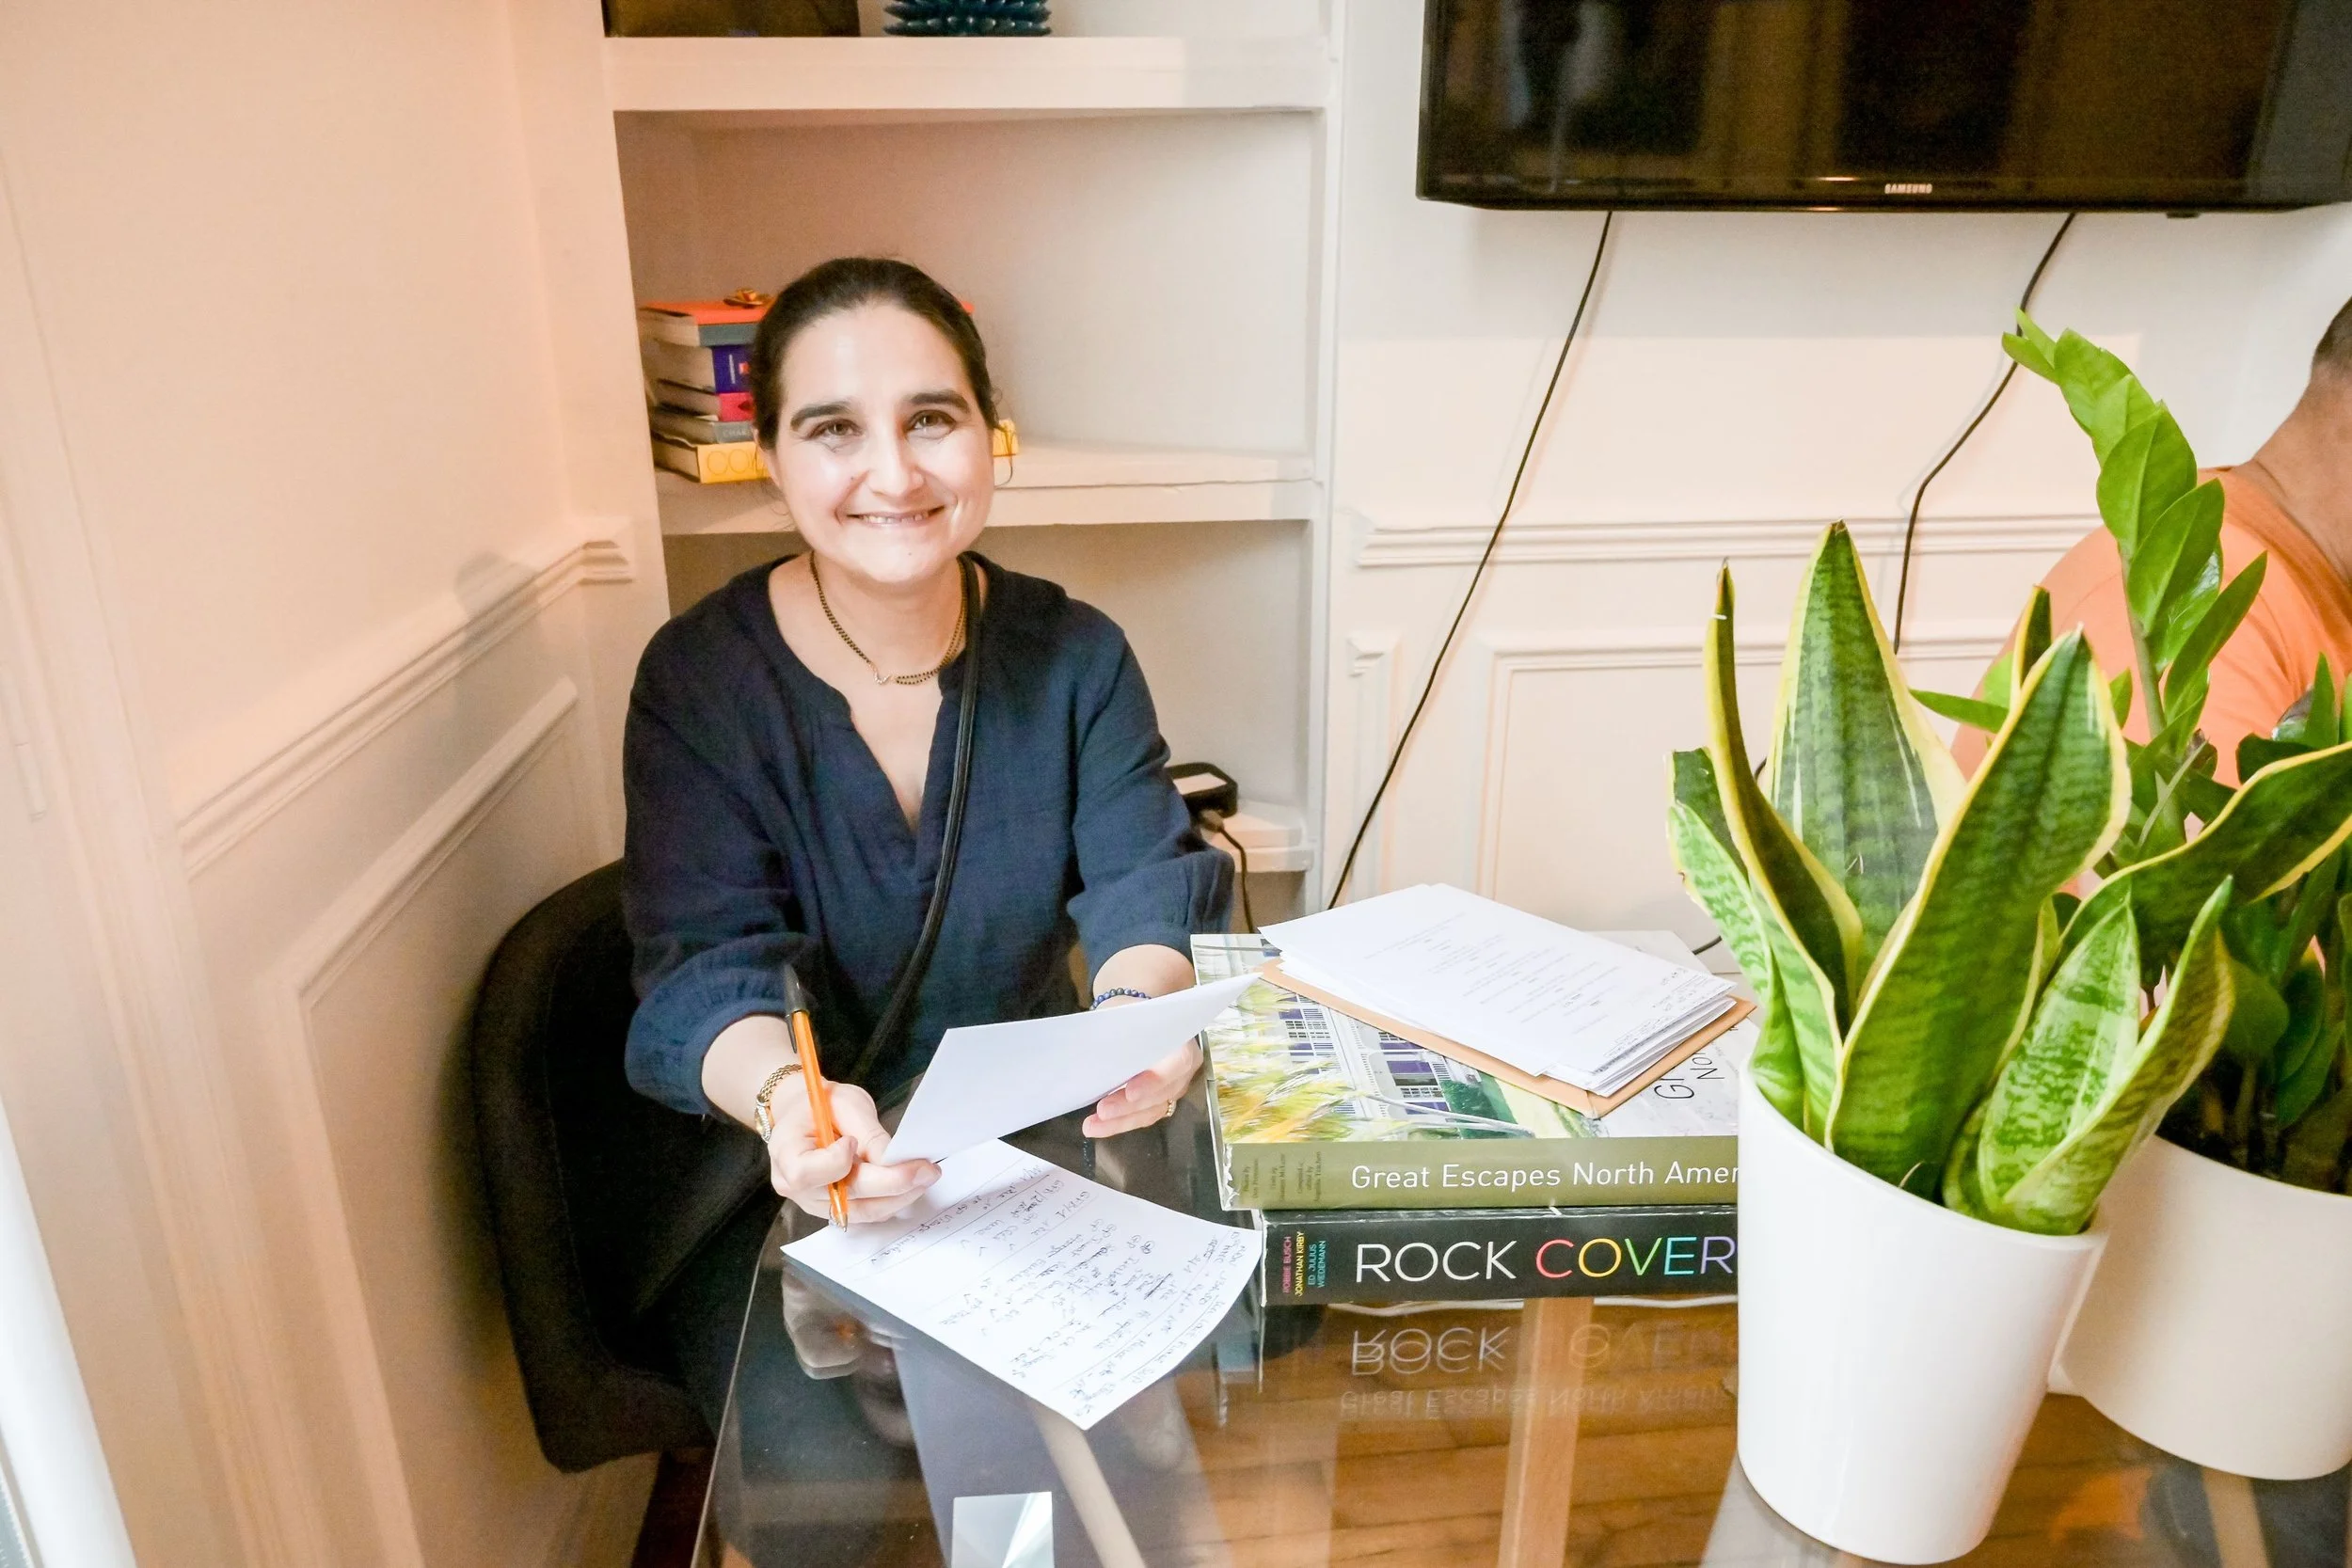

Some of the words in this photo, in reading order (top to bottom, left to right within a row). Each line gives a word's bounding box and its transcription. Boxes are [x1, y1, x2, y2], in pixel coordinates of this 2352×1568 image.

[1884, 183, 1932, 195] SAMSUNG
[1352, 1165, 1430, 1189] Great
[1442, 1164, 1562, 1192] Escapes
[1573, 1162, 1654, 1185] North
[1283, 1236, 1292, 1264] BUSCH
[1296, 1231, 1305, 1254] KIRBY
[1309, 1243, 1317, 1272] JULIUS
[1317, 1240, 1327, 1288] WIEDEMANN
[1356, 1240, 1518, 1283] ROCK
[1535, 1235, 1738, 1278] COVER
[1295, 1255, 1305, 1296] JONATHAN
